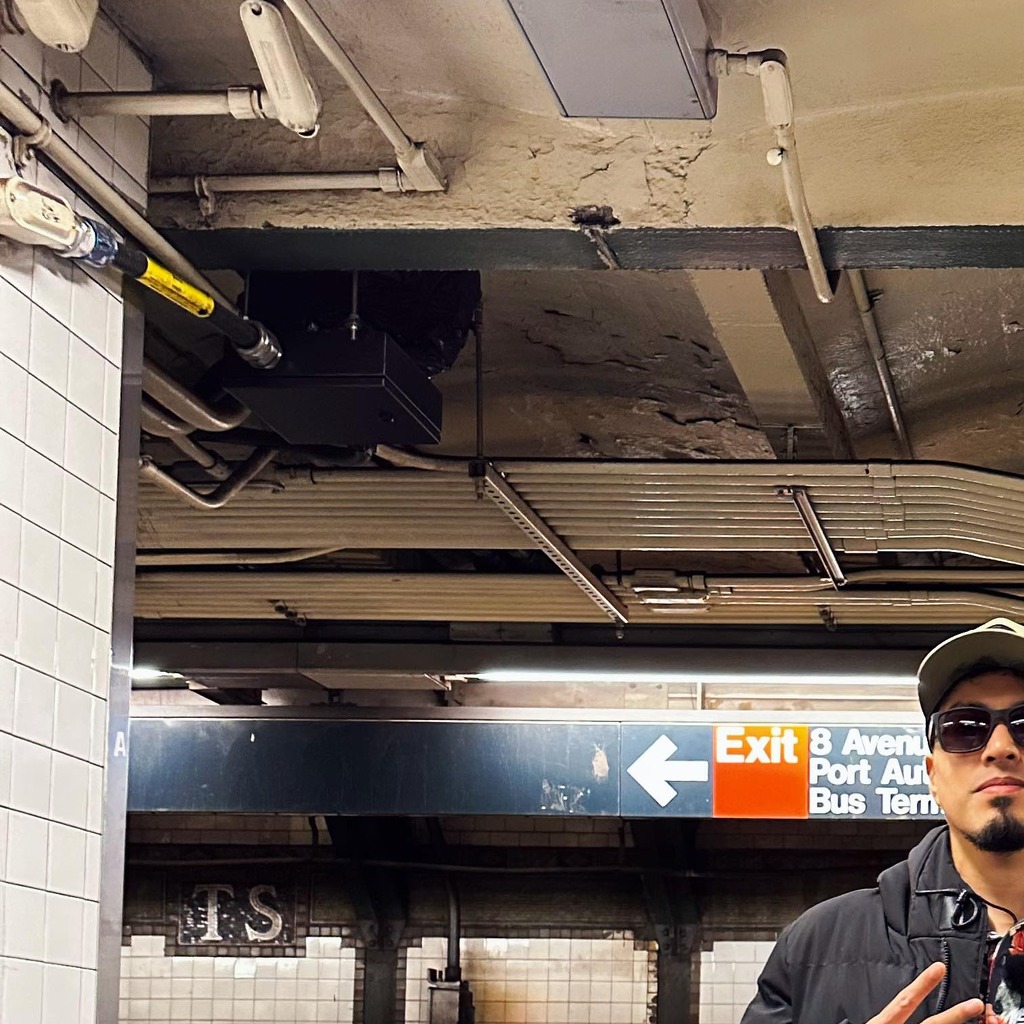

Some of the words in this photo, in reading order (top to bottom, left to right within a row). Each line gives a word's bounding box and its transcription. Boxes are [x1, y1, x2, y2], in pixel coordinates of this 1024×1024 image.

[113, 731, 126, 757] A
[716, 727, 798, 764] Exit
[810, 728, 832, 756] 8
[841, 728, 932, 756] Avenu
[809, 757, 872, 785] Port
[809, 787, 866, 814] Bus
[875, 787, 946, 814] Term
